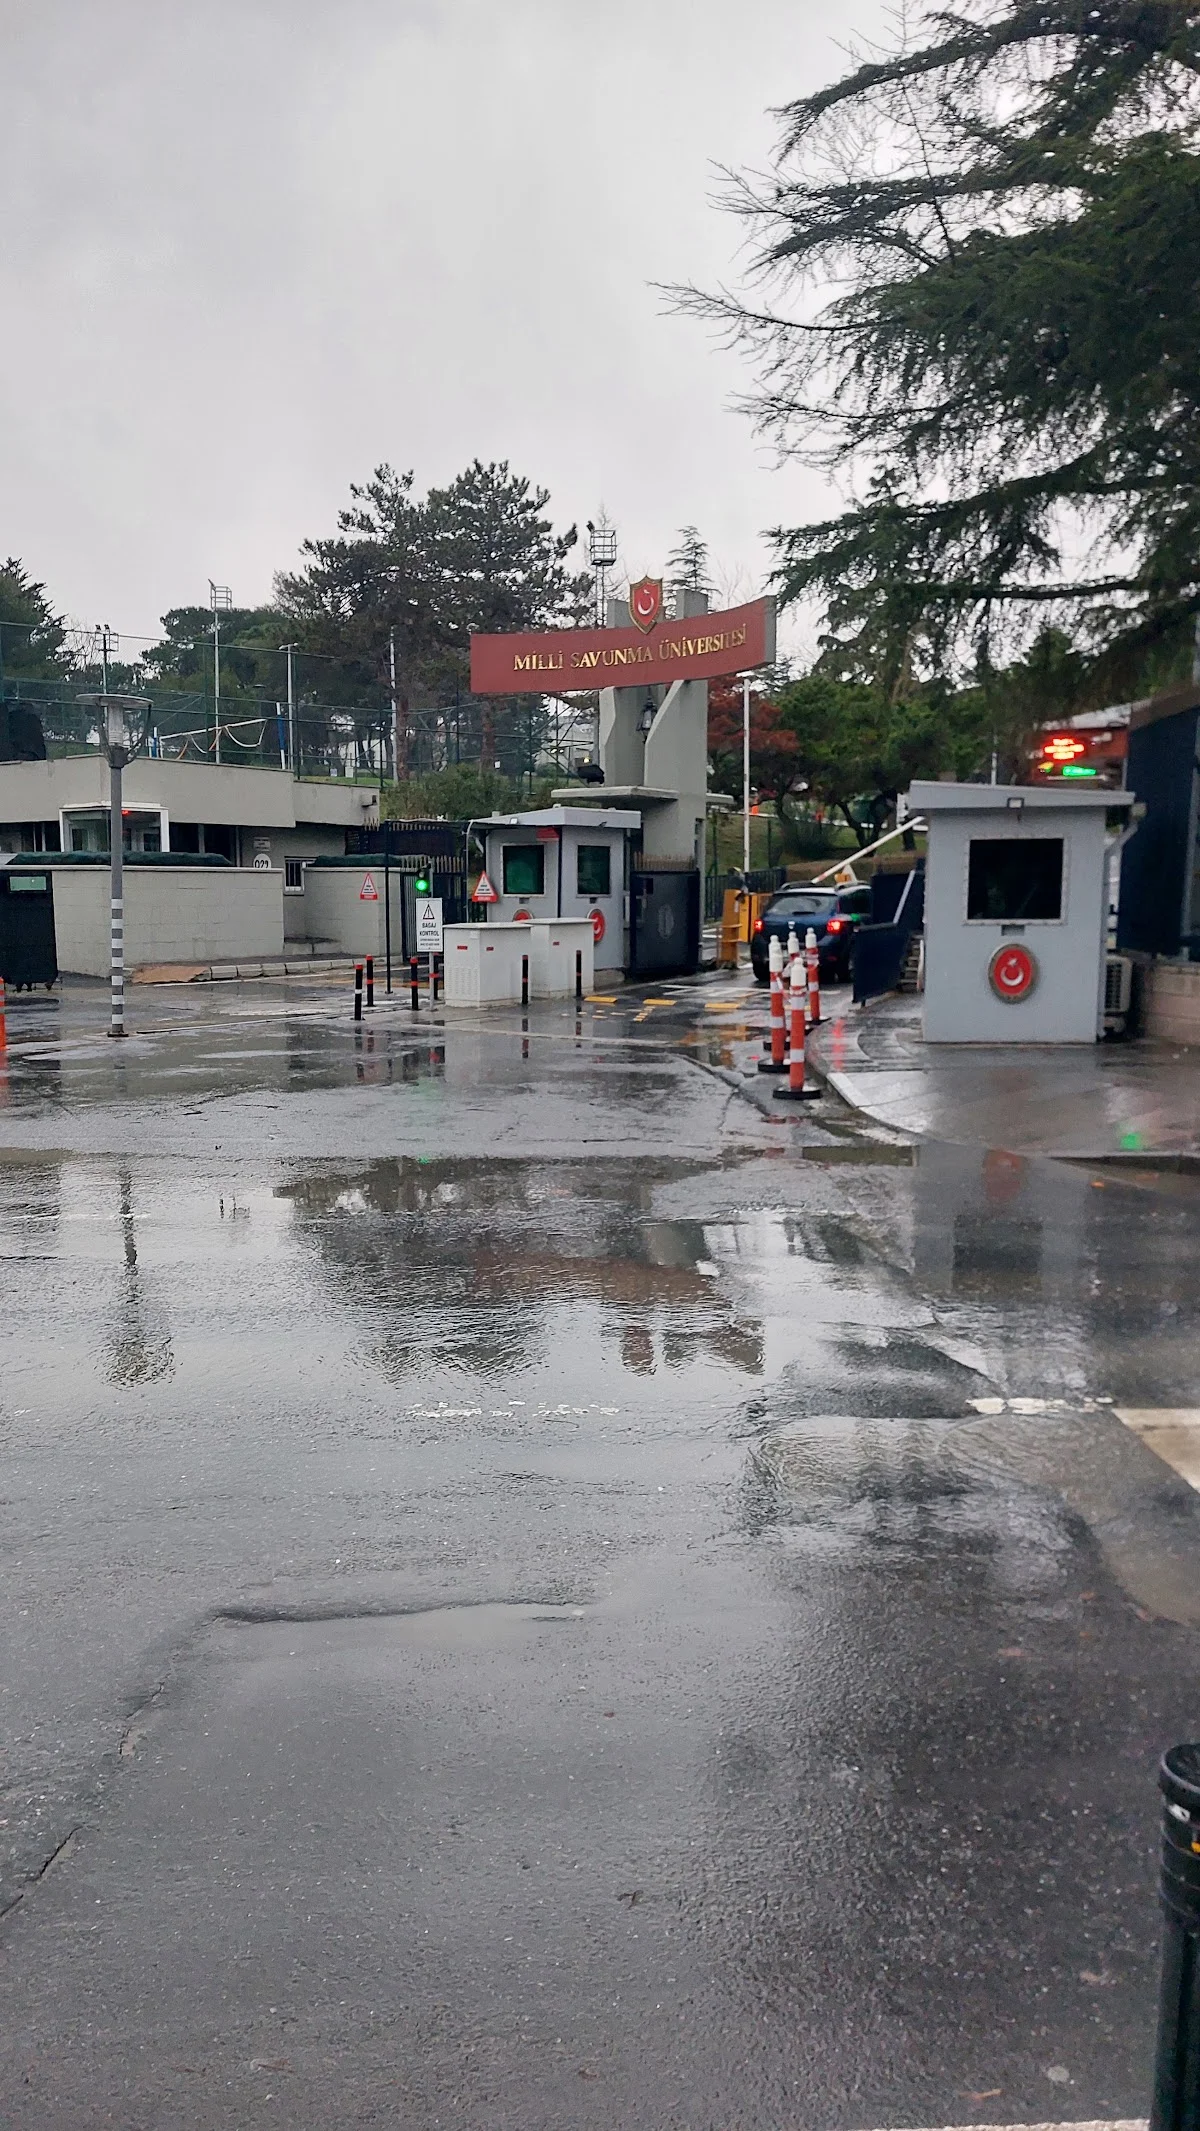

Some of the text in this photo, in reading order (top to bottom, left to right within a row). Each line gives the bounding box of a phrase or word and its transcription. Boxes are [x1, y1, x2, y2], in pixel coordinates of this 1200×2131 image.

[513, 623, 747, 671] MİLLİ SAVUNMA ÜNİVERSİTESİ
